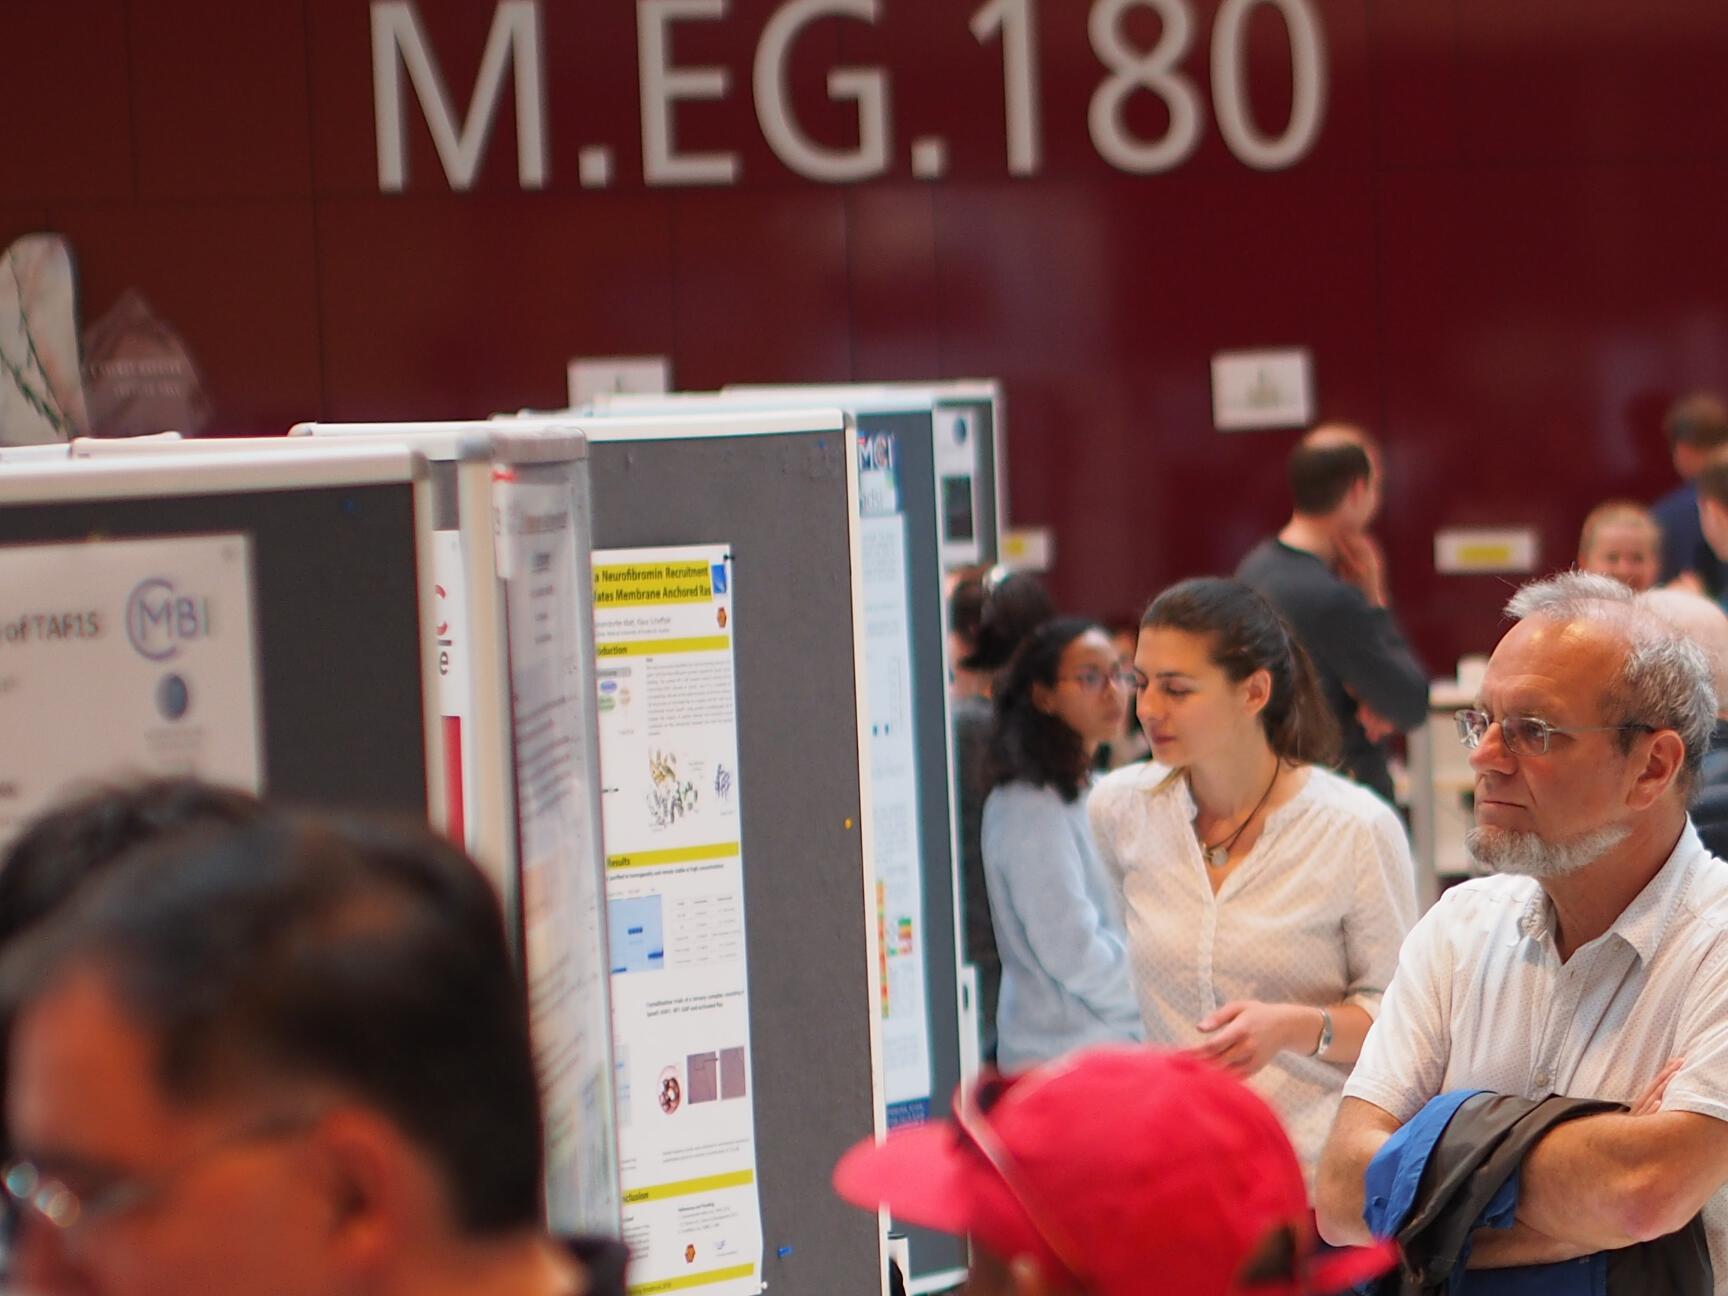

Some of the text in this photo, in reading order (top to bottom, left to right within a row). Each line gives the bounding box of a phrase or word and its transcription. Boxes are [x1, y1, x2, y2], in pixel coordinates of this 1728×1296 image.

[367, 0, 1327, 191] M.EG.180
[602, 569, 662, 582] Neurofibromin
[666, 566, 708, 578] Recruitment
[616, 588, 661, 601] Membrane
[663, 585, 698, 599] Anchored
